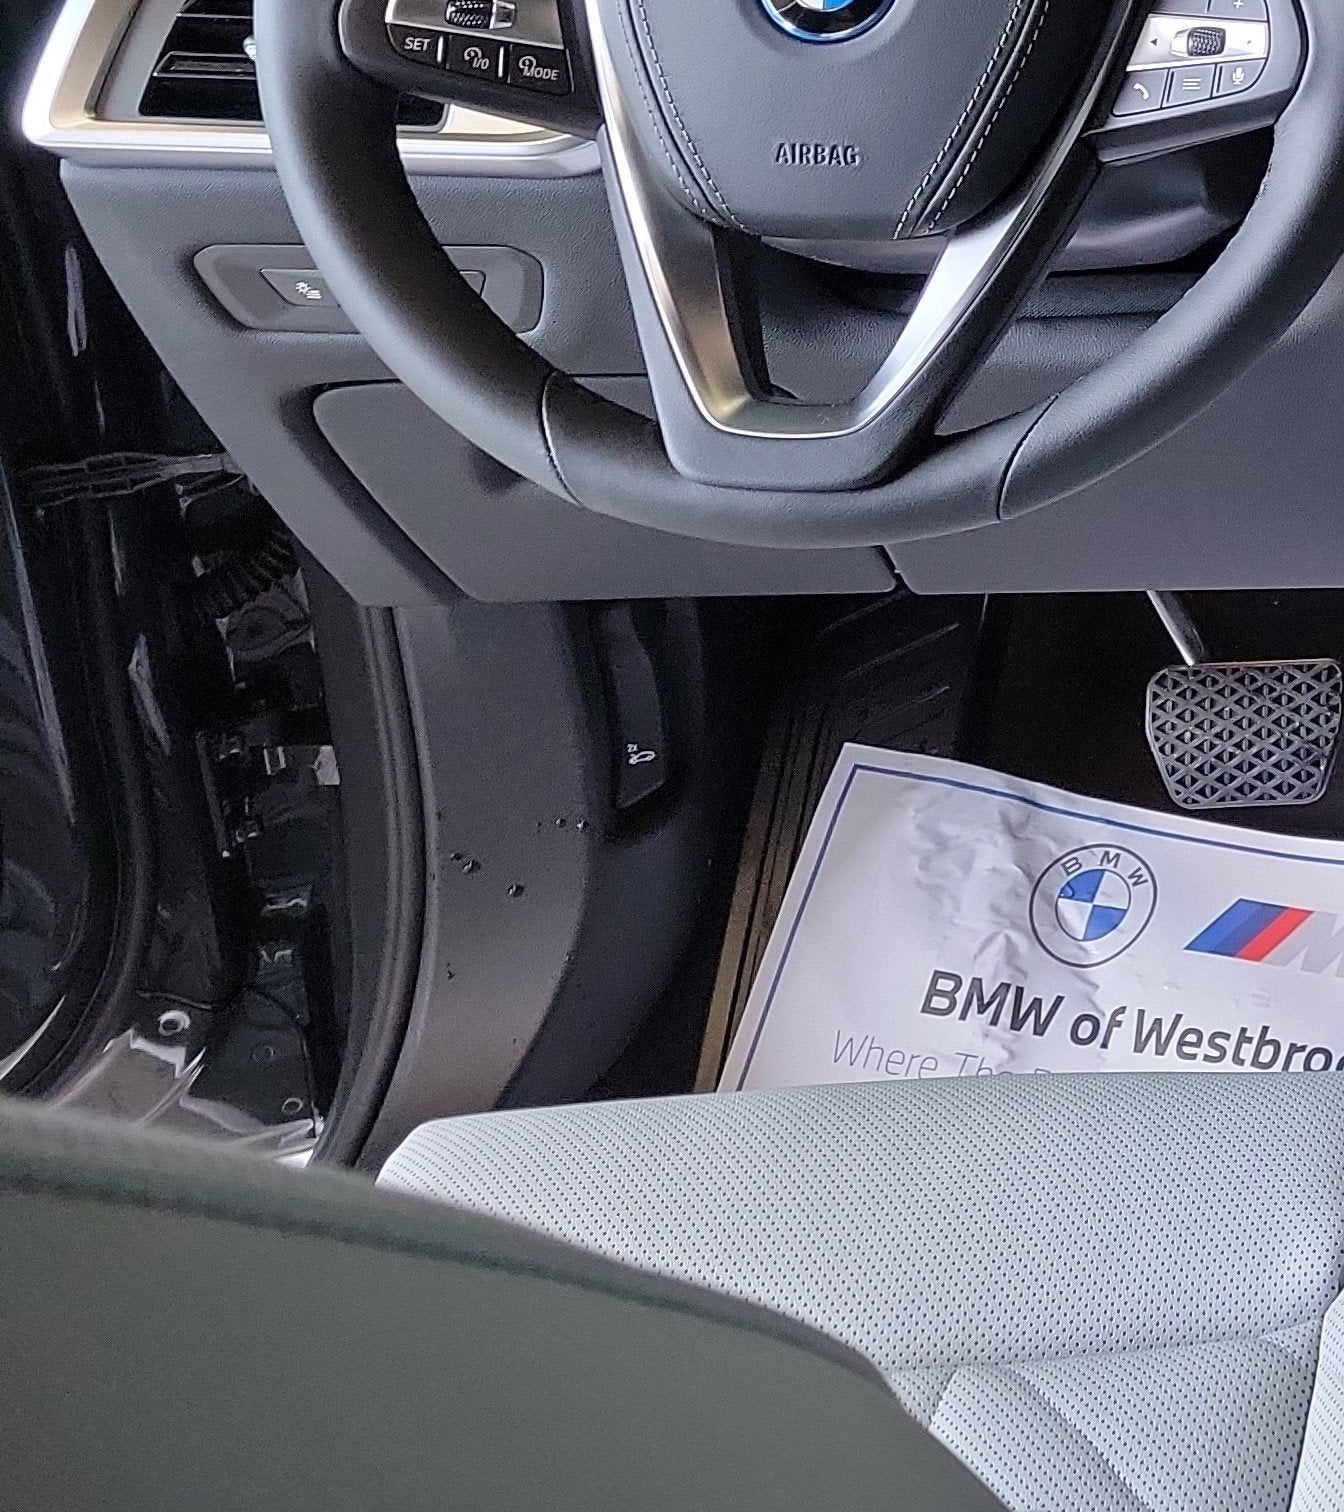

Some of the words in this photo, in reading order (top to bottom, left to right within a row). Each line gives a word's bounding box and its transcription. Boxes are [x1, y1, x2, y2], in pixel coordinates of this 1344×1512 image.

[404, 36, 431, 51] SET
[523, 68, 560, 81] MODE
[775, 141, 861, 167] AIRBAG
[1063, 850, 1148, 888] BMW
[920, 969, 1065, 1037] BMW
[1070, 1005, 1128, 1049] of
[833, 1029, 939, 1080] Where
[955, 1052, 1013, 1078] Th
